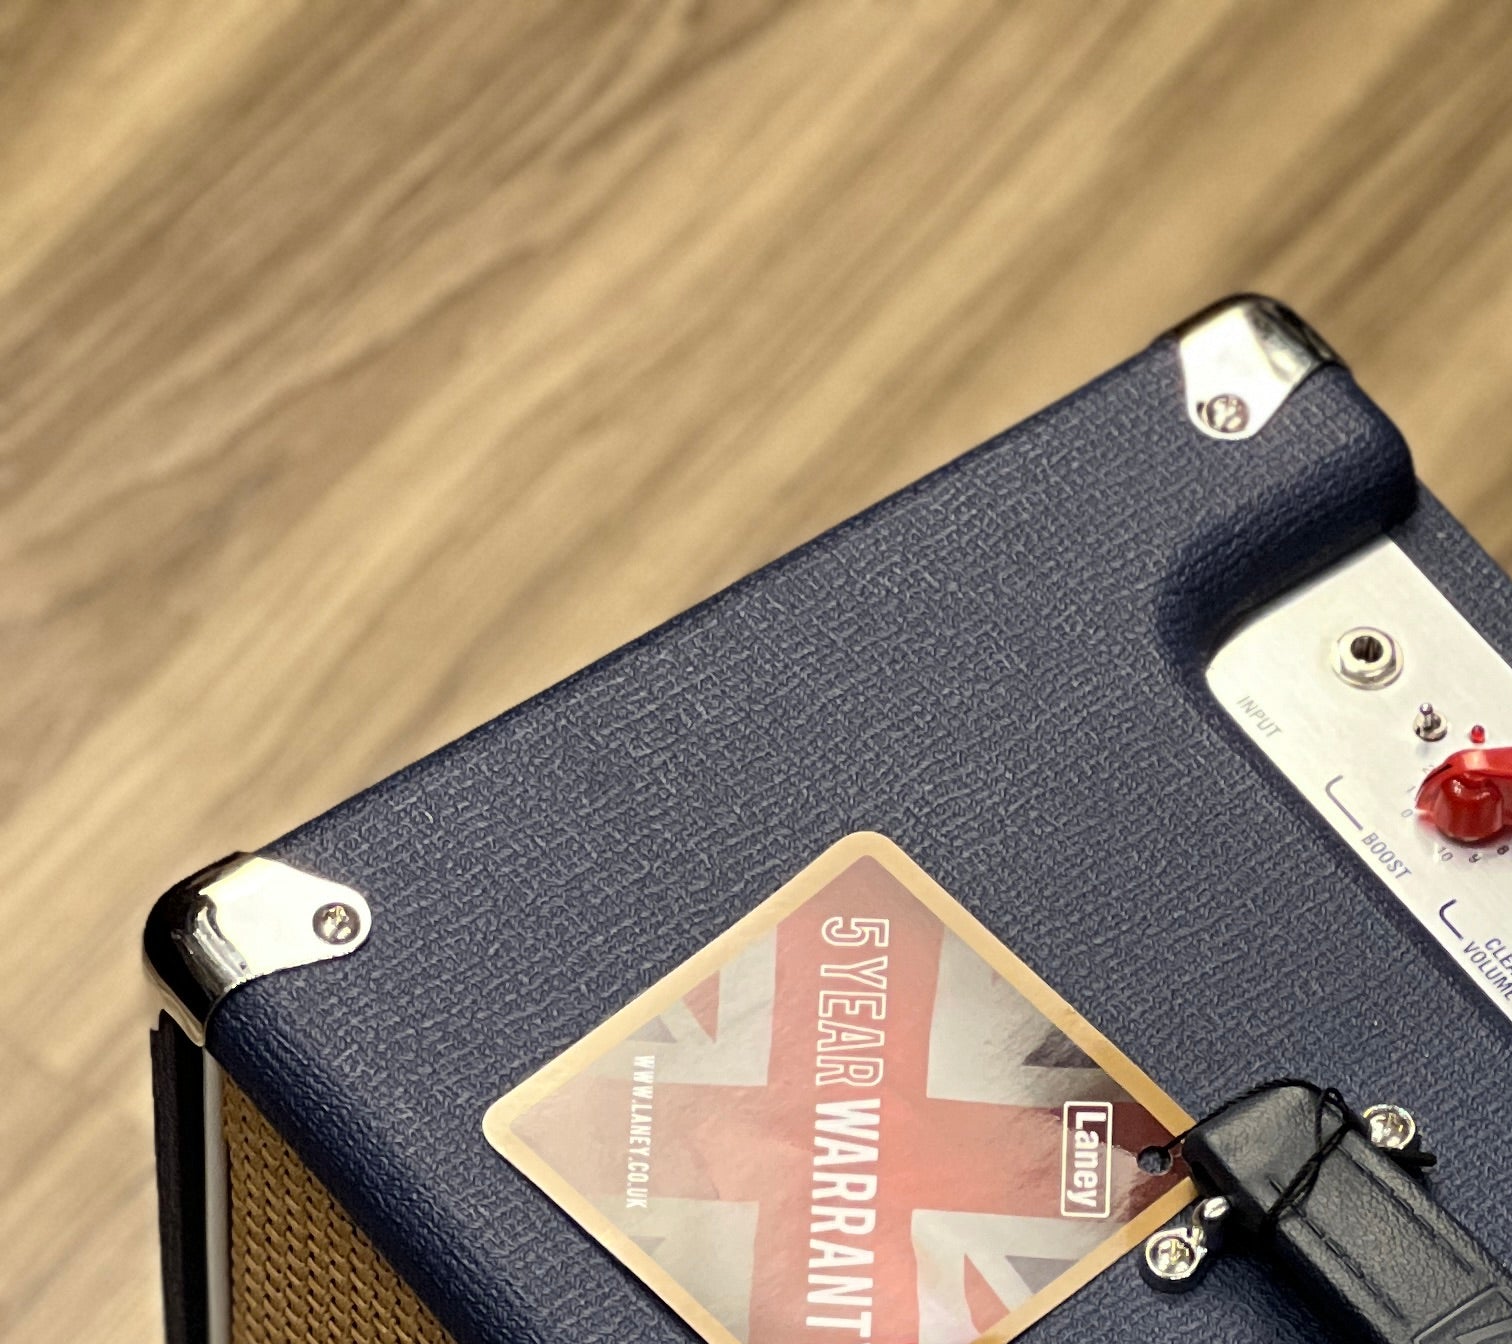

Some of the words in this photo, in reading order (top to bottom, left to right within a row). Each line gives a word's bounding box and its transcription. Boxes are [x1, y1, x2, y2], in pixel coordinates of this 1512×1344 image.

[1237, 696, 1282, 737] INPUT
[1361, 832, 1412, 879] BOOST
[821, 915, 890, 948] 5
[815, 955, 888, 1088] YEAR
[625, 1055, 656, 1209] WWW.LANEY.CO.UK
[1065, 1111, 1108, 1209] Laney
